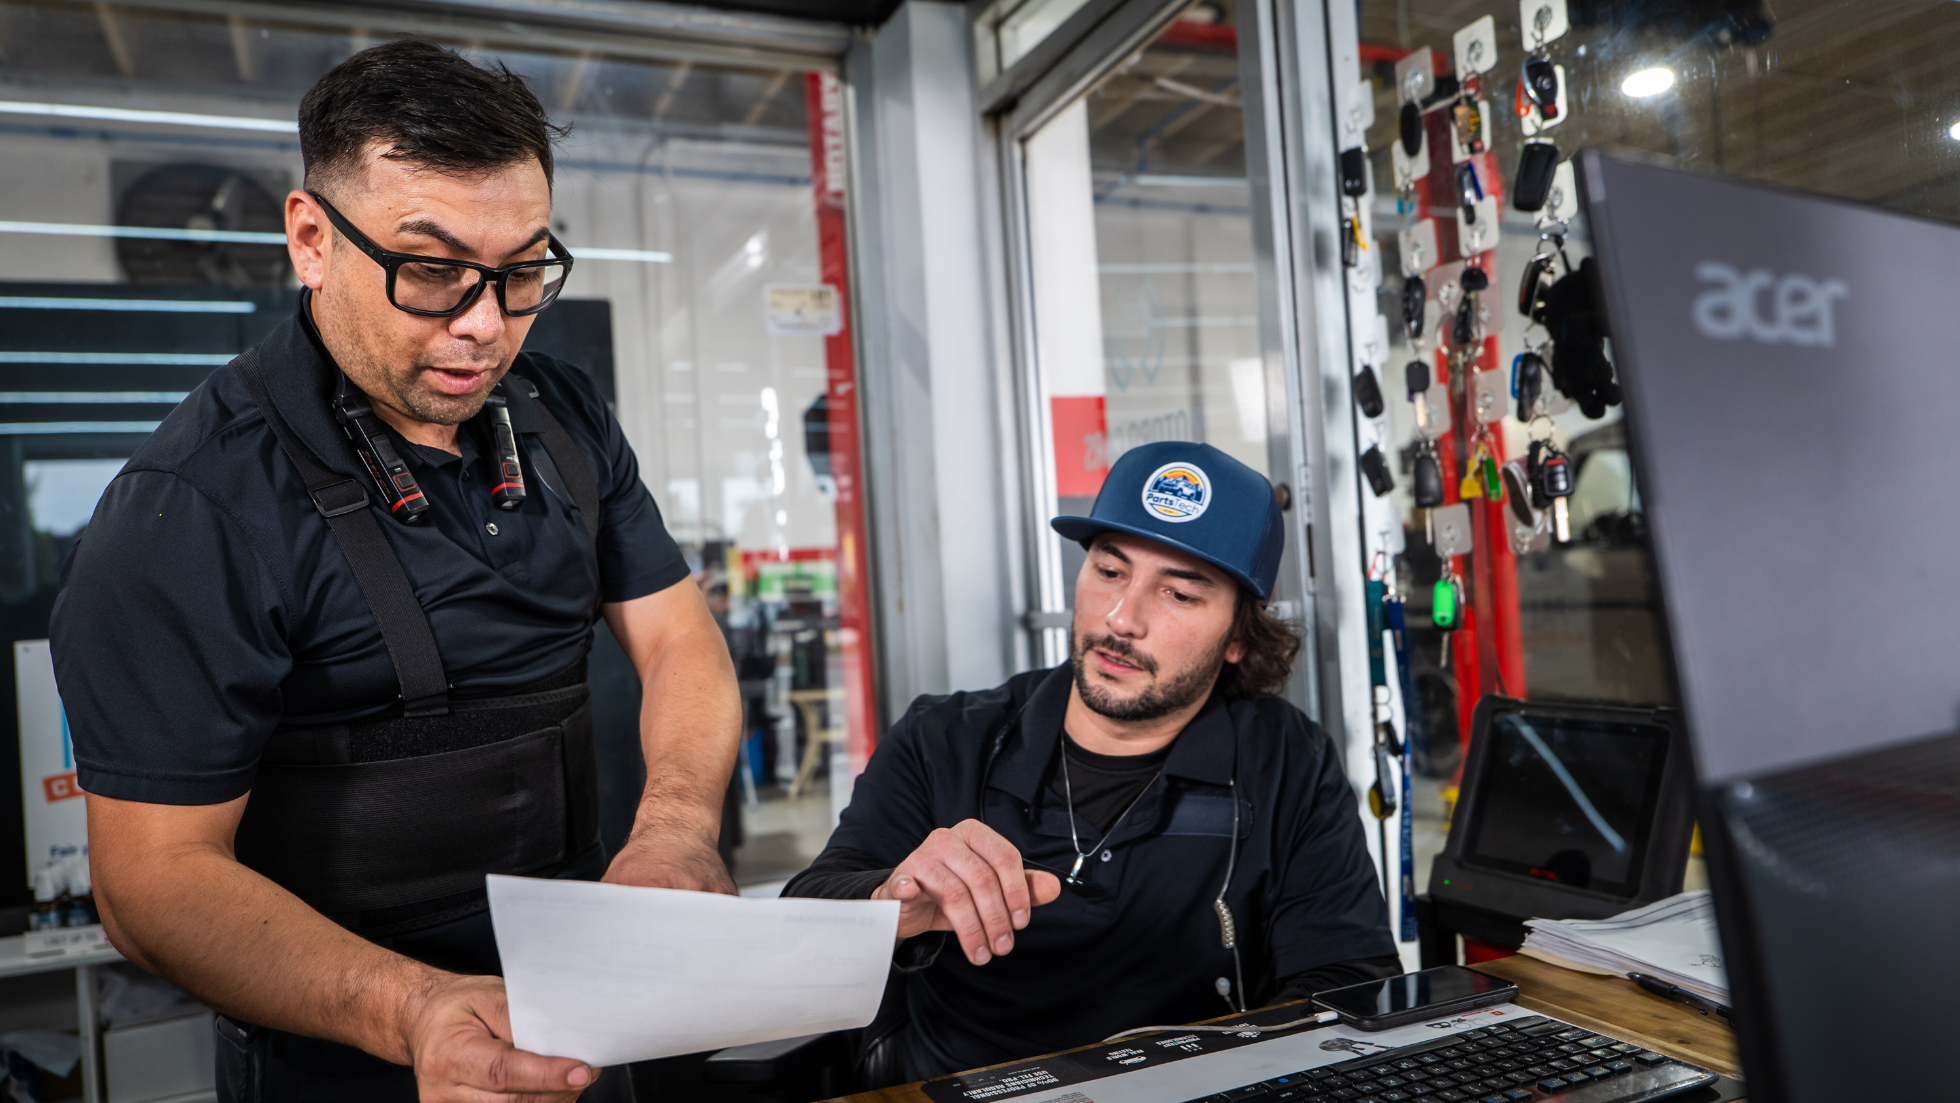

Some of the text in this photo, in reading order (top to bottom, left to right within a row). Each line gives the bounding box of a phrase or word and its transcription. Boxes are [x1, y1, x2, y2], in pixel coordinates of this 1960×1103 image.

[1693, 261, 1849, 346] acer
[1146, 493, 1200, 515] PartsTech
[1005, 1074, 1054, 1087] TECHNICIANS
[963, 1084, 1005, 1097] REGULARLY
[970, 1085, 1026, 1099] PROFESSIONAL
